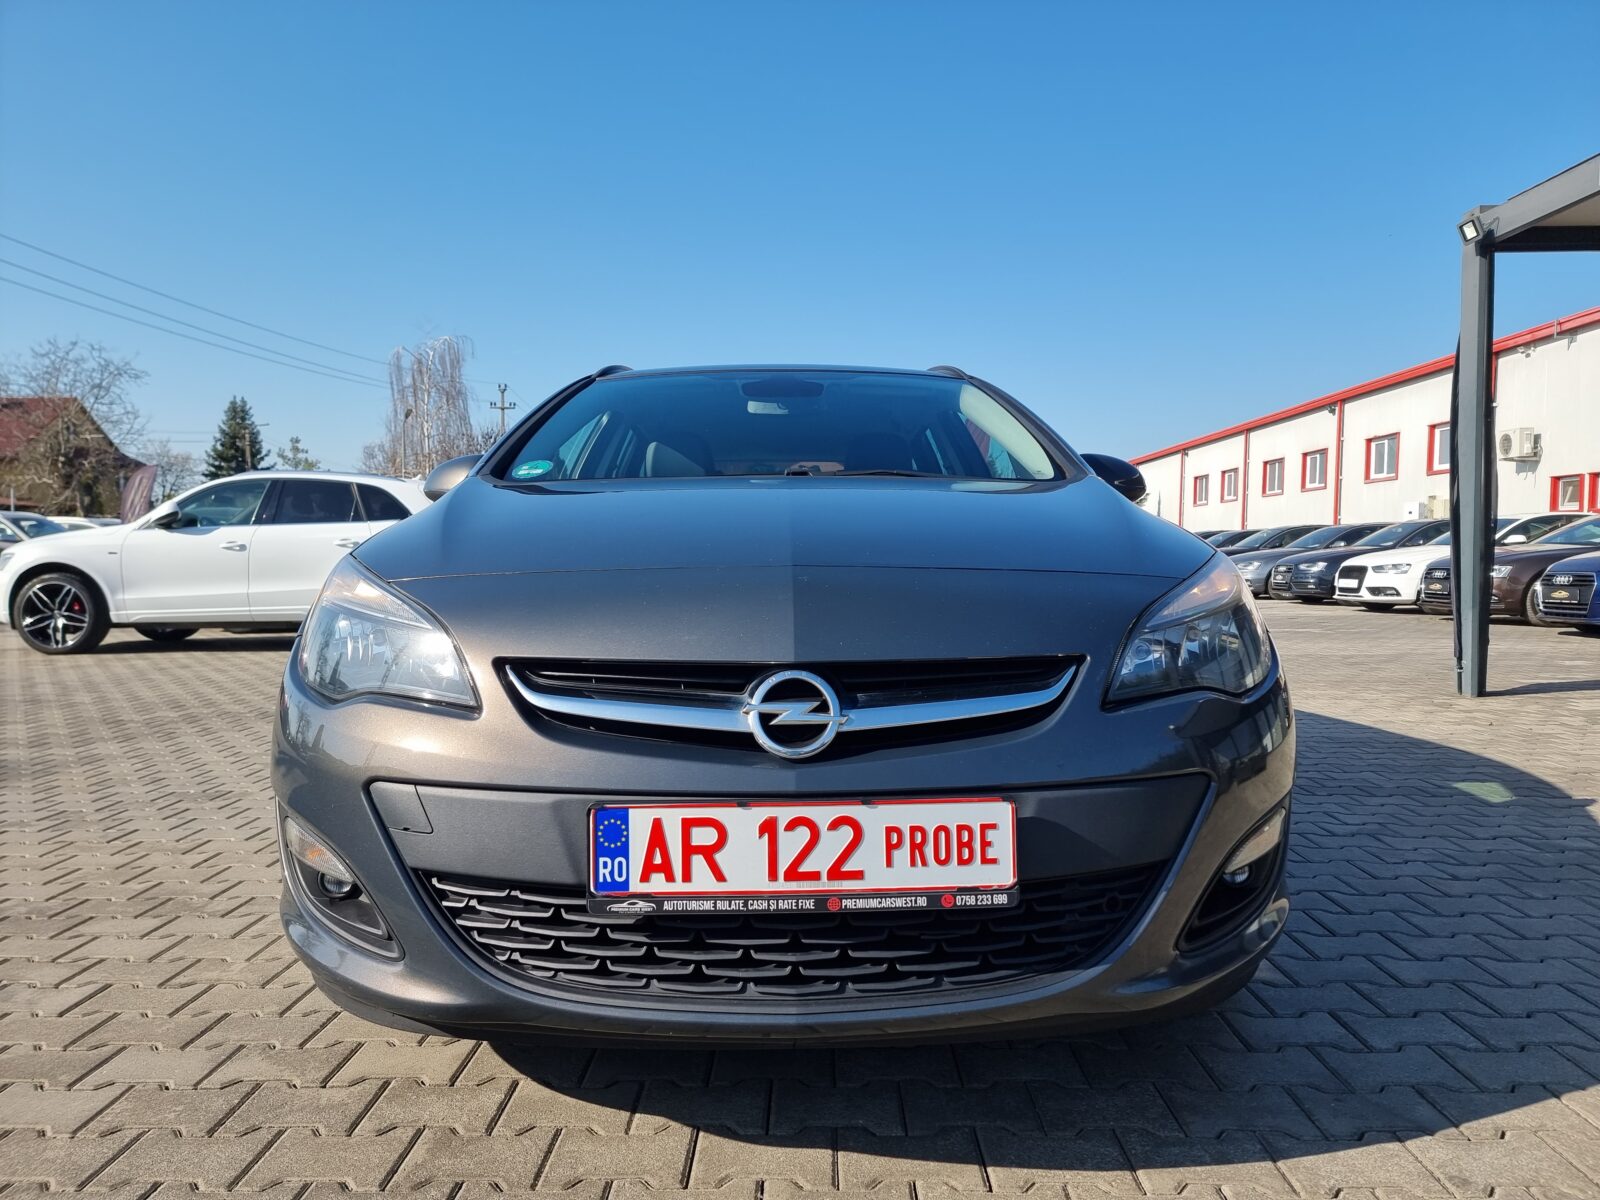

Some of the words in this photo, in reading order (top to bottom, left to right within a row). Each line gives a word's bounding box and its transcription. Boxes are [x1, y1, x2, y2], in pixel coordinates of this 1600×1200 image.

[639, 816, 727, 883] AR
[758, 815, 864, 882] 122
[885, 822, 998, 868] PROBE
[599, 857, 627, 882] RO
[663, 900, 715, 911] AUTOTURISME
[717, 900, 746, 911] RULATE,
[748, 899, 767, 910] CASH
[778, 899, 797, 910] RATE
[799, 899, 815, 909] FIXE
[842, 896, 927, 909] PREMIUMCARSWEST.RO
[956, 895, 975, 906] 0758
[977, 894, 991, 905] 233
[993, 893, 1008, 905] 699
